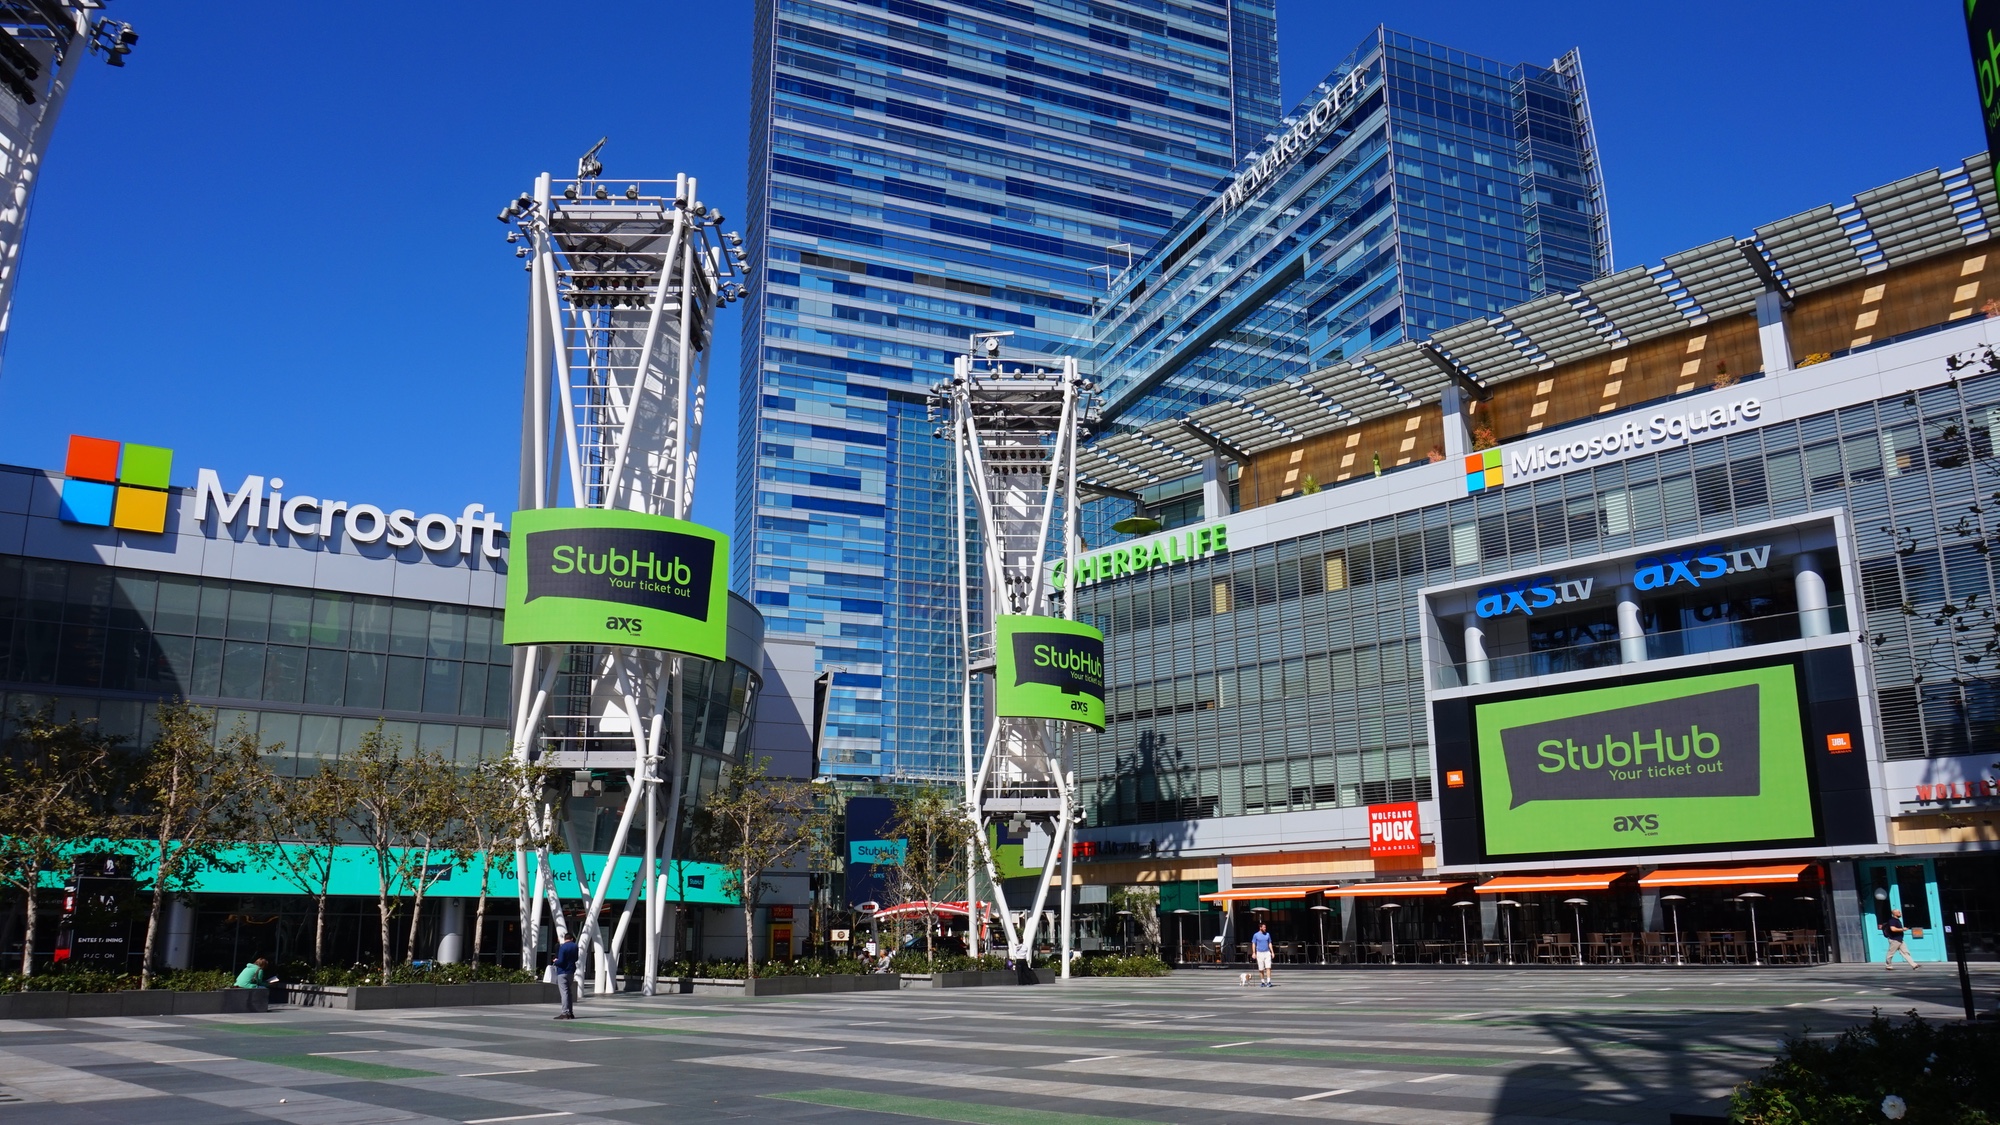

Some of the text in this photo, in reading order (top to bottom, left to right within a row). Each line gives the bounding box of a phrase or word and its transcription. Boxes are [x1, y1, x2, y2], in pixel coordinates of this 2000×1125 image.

[1249, 64, 1371, 189] MARRIOTT
[1510, 397, 1762, 478] Microsoft Square
[194, 467, 503, 558] Microsoft
[1078, 523, 1229, 584] HERBALIFE
[551, 545, 692, 585] StubHub
[609, 577, 691, 598] Your ticket out
[605, 616, 643, 633] axs
[1034, 644, 1102, 678] StubHub
[1070, 700, 1088, 713] axs
[1537, 725, 1721, 773] StubHub
[1609, 760, 1723, 781] Your ticket out
[1916, 780, 2000, 800] WOLFG
[1371, 810, 1412, 820] WOLFGANG
[1613, 813, 1659, 834] axs
[1372, 820, 1415, 842] PUCK
